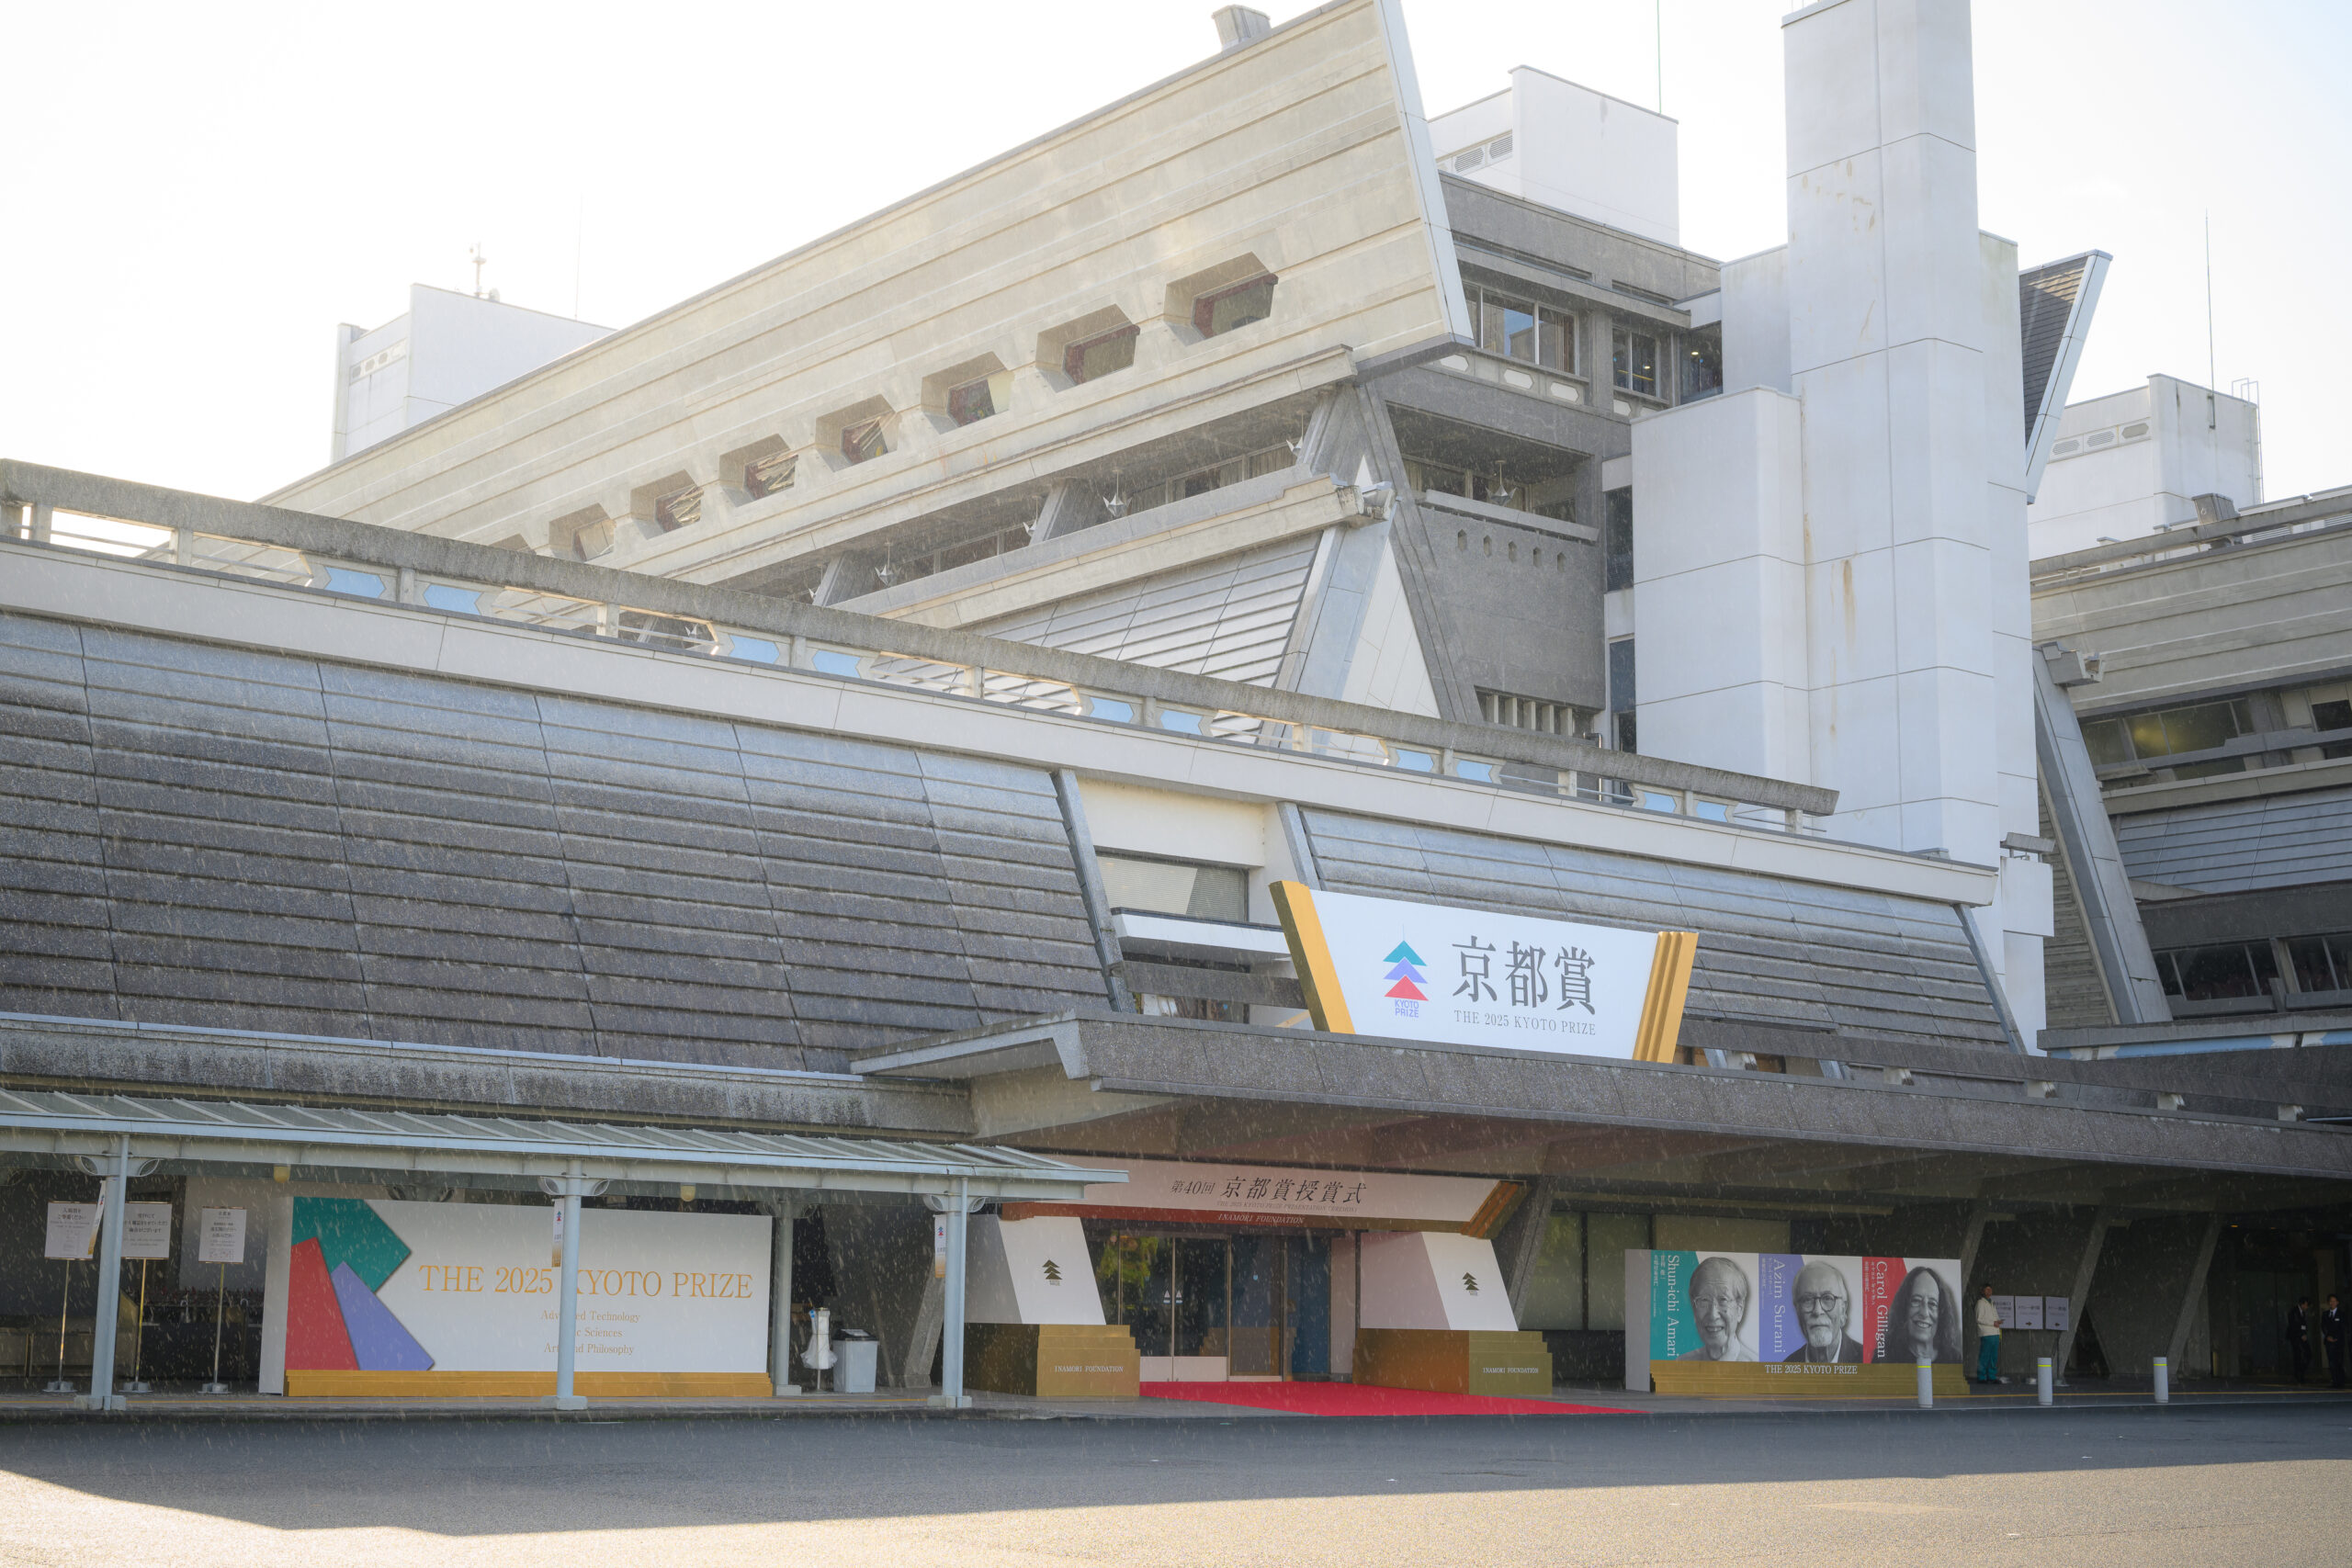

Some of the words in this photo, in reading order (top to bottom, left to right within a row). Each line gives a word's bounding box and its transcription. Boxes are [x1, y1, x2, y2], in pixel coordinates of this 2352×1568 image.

[1452, 935, 1596, 1015] 京都賞
[1395, 998, 1419, 1009] KYOTO
[1395, 1008, 1419, 1018] PRIZE
[1453, 1010, 1480, 1024] THE
[1484, 1012, 1510, 1027] 2025
[1514, 1016, 1556, 1032] KYOTO
[1561, 1021, 1596, 1036] PRIZE
[1171, 1179, 1216, 1195] 第40回
[1220, 1176, 1367, 1204] 京都賞授賞式
[1217, 1213, 1253, 1223] INAMORI
[1255, 1215, 1306, 1224] FOUNDATION
[419, 1264, 484, 1292] THE
[493, 1266, 553, 1294] 2025
[672, 1271, 753, 1299] PRIZE
[1668, 1255, 1680, 1312] Shun-ichi
[1774, 1258, 1786, 1298] Azim
[1876, 1260, 1888, 1300] Carol
[541, 1309, 586, 1321] Adved
[590, 1310, 640, 1324] Technology
[1774, 1304, 1786, 1353] Surani
[584, 1326, 623, 1337] Sciences
[1668, 1315, 1680, 1357] Amari
[1875, 1304, 1889, 1359] Gilligan
[587, 1343, 635, 1356] Philosophy
[1084, 1365, 1124, 1373] FOUNDATION
[1483, 1366, 1506, 1374] INAMORI
[1507, 1366, 1539, 1374] FOUNDATION
[1764, 1364, 1782, 1374] THE
[1784, 1364, 1802, 1374] 2025
[1803, 1365, 1832, 1374] KYOTO
[1833, 1365, 1858, 1375] PRIZE
